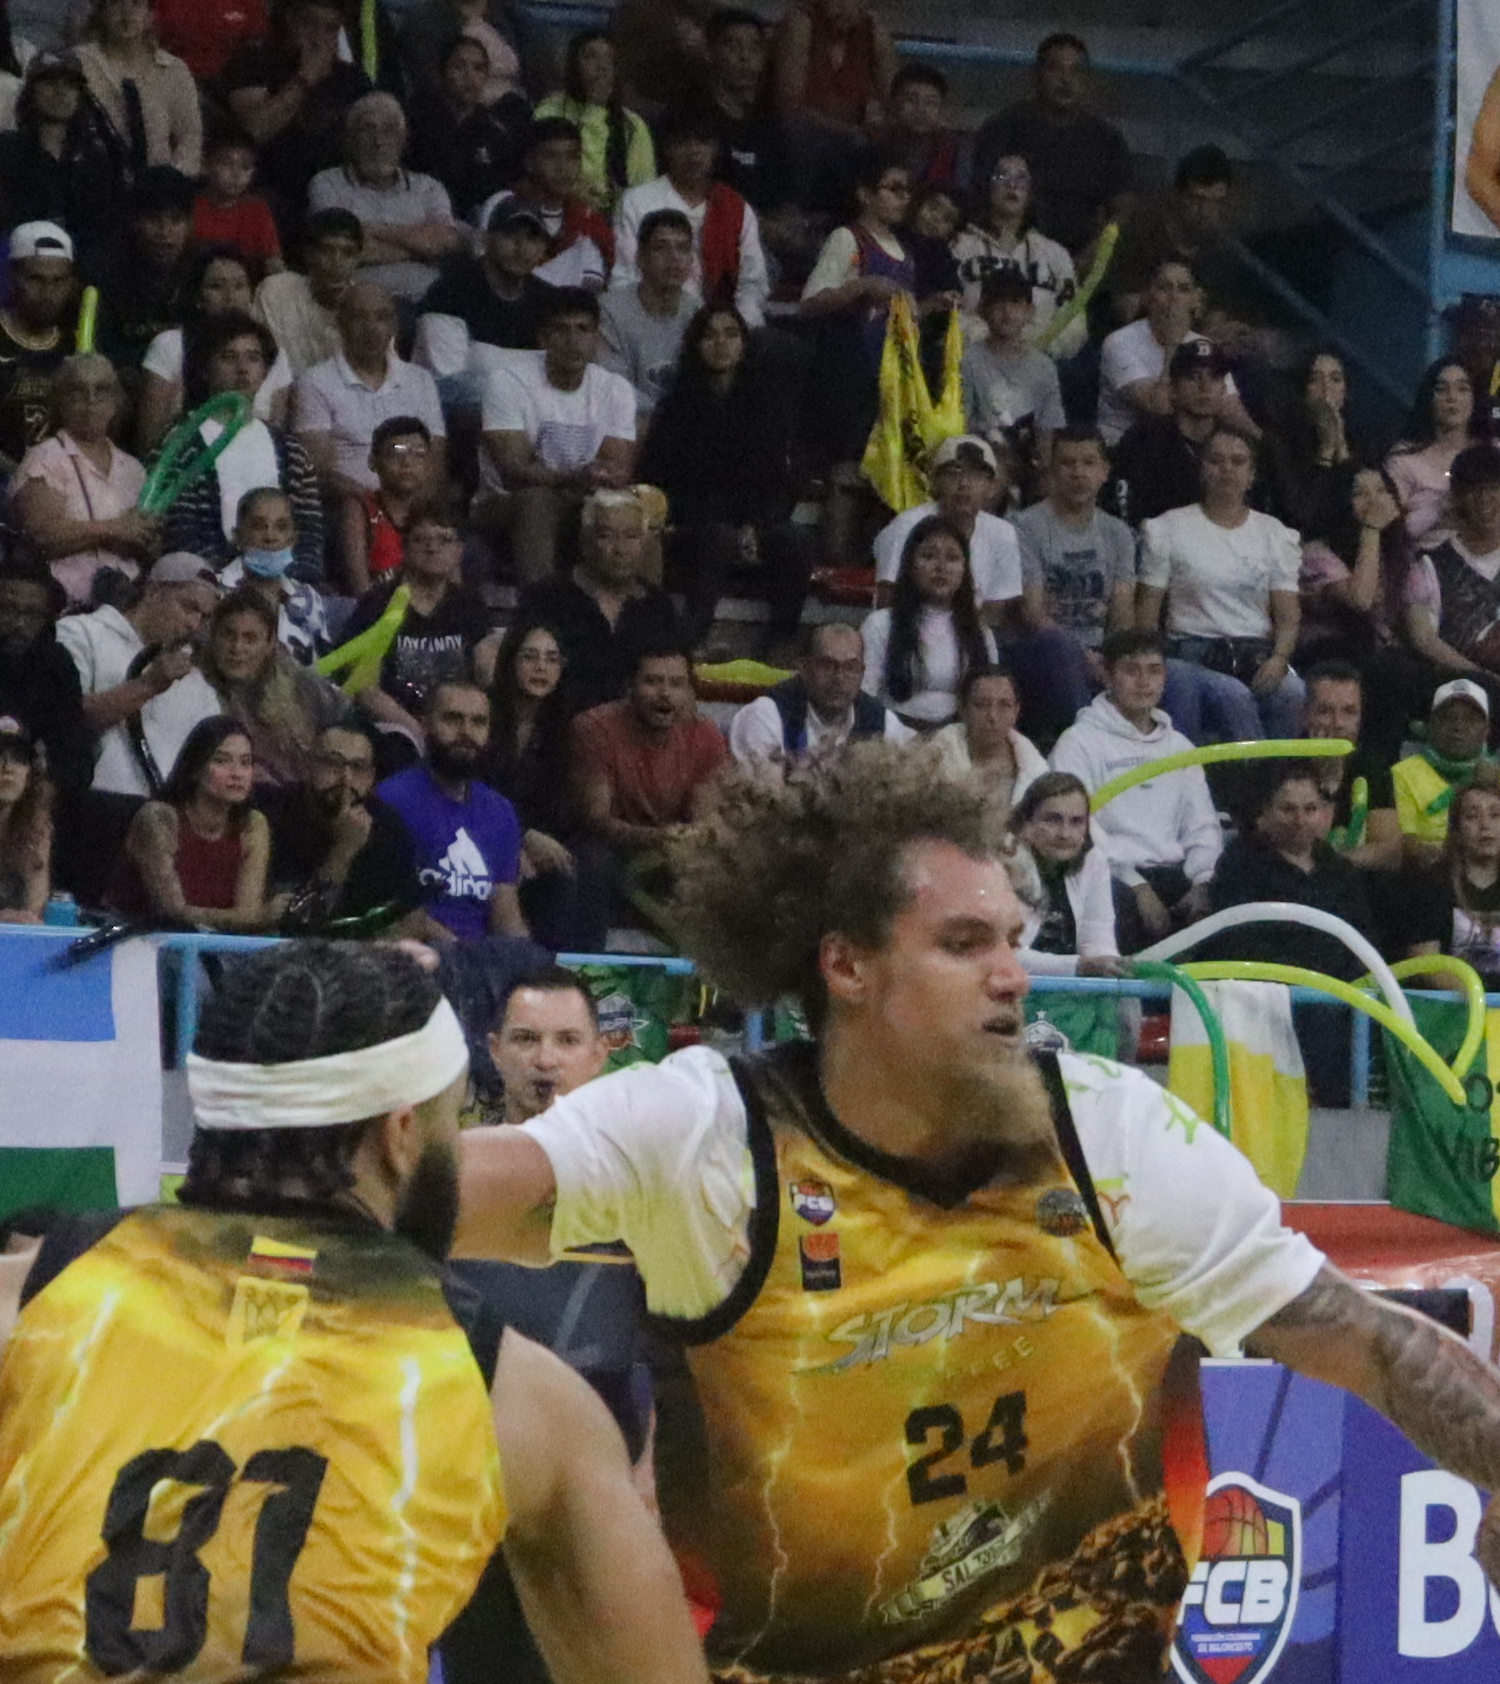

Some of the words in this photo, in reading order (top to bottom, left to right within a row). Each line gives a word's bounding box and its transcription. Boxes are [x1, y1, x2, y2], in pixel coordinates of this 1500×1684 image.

[790, 1277, 1088, 1374] STORM
[903, 1390, 1029, 1507] 24
[84, 1438, 329, 1676] 81
[1175, 1560, 1288, 1625] FCB
